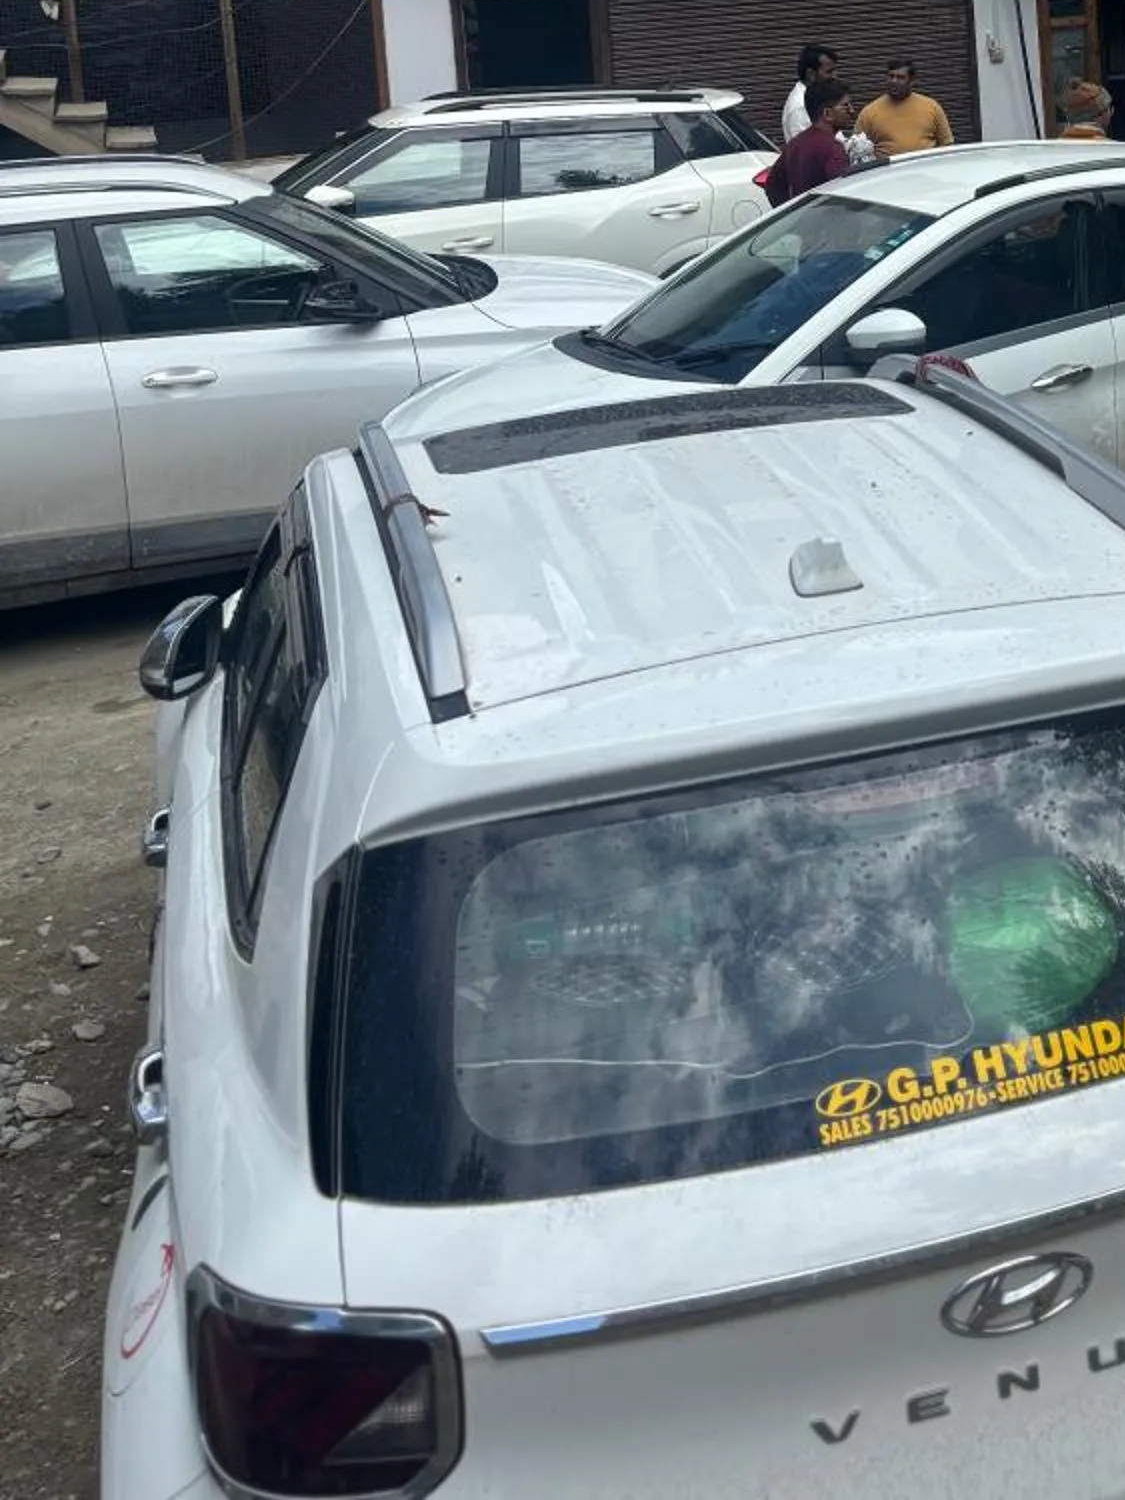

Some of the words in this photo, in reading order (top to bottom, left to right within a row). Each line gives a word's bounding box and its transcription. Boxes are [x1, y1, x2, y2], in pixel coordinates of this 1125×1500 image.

[819, 1114, 872, 1145] SALES
[877, 1088, 988, 1131] 7510000976
[996, 1068, 1065, 1102] SERVICE
[886, 1057, 967, 1103] G.P.
